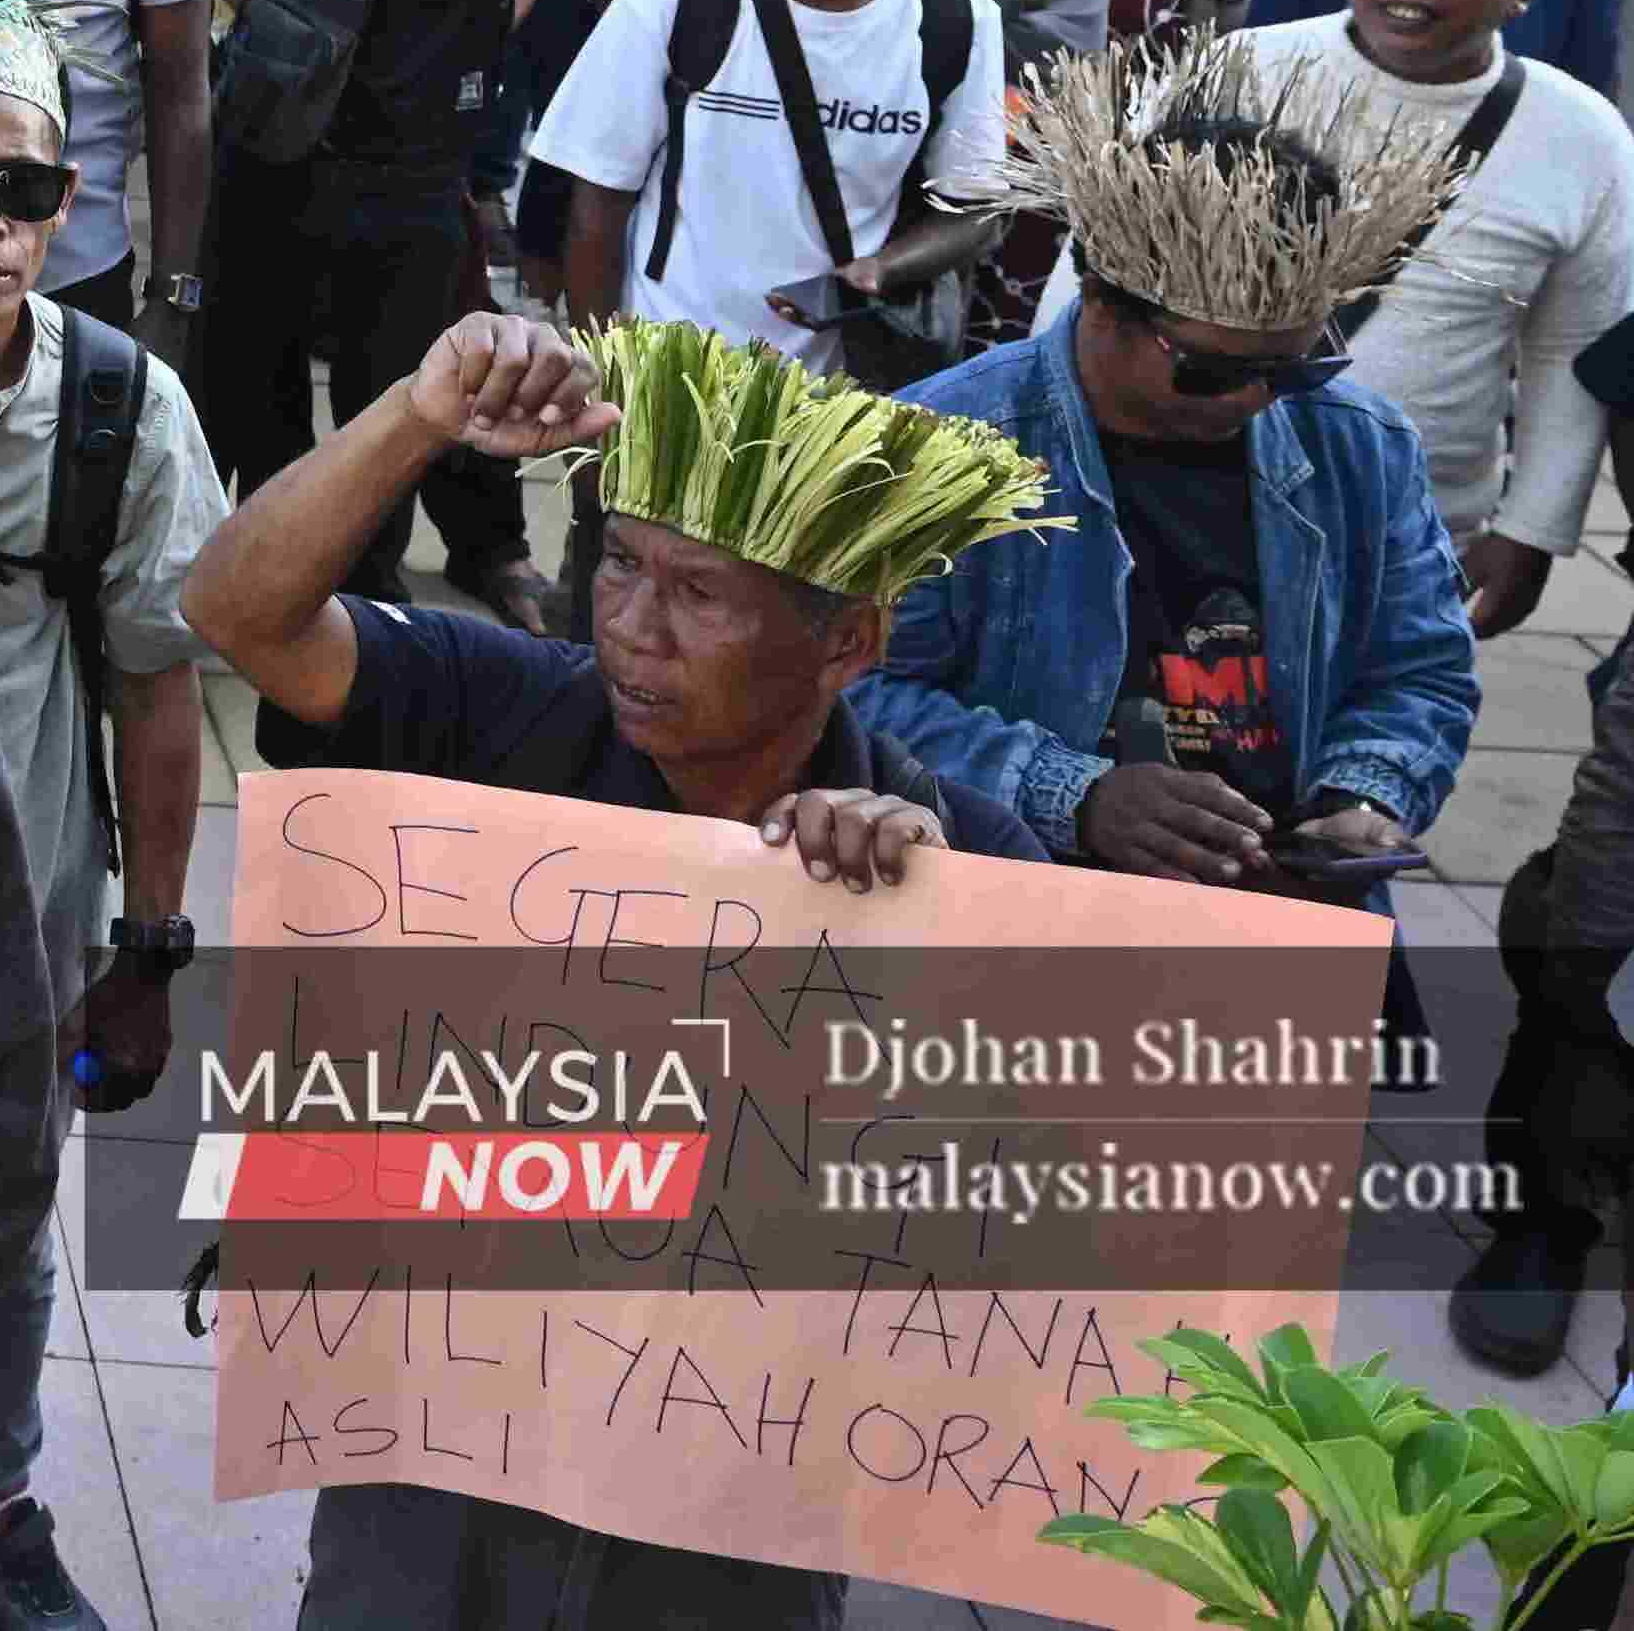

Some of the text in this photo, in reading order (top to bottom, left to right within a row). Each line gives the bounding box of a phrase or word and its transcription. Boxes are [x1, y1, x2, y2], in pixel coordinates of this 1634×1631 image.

[815, 100, 923, 136] didas
[281, 793, 891, 1066] SEGERA
[249, 1265, 1176, 1521] WILIYAH ORAN
[267, 1400, 511, 1474] ASLI
